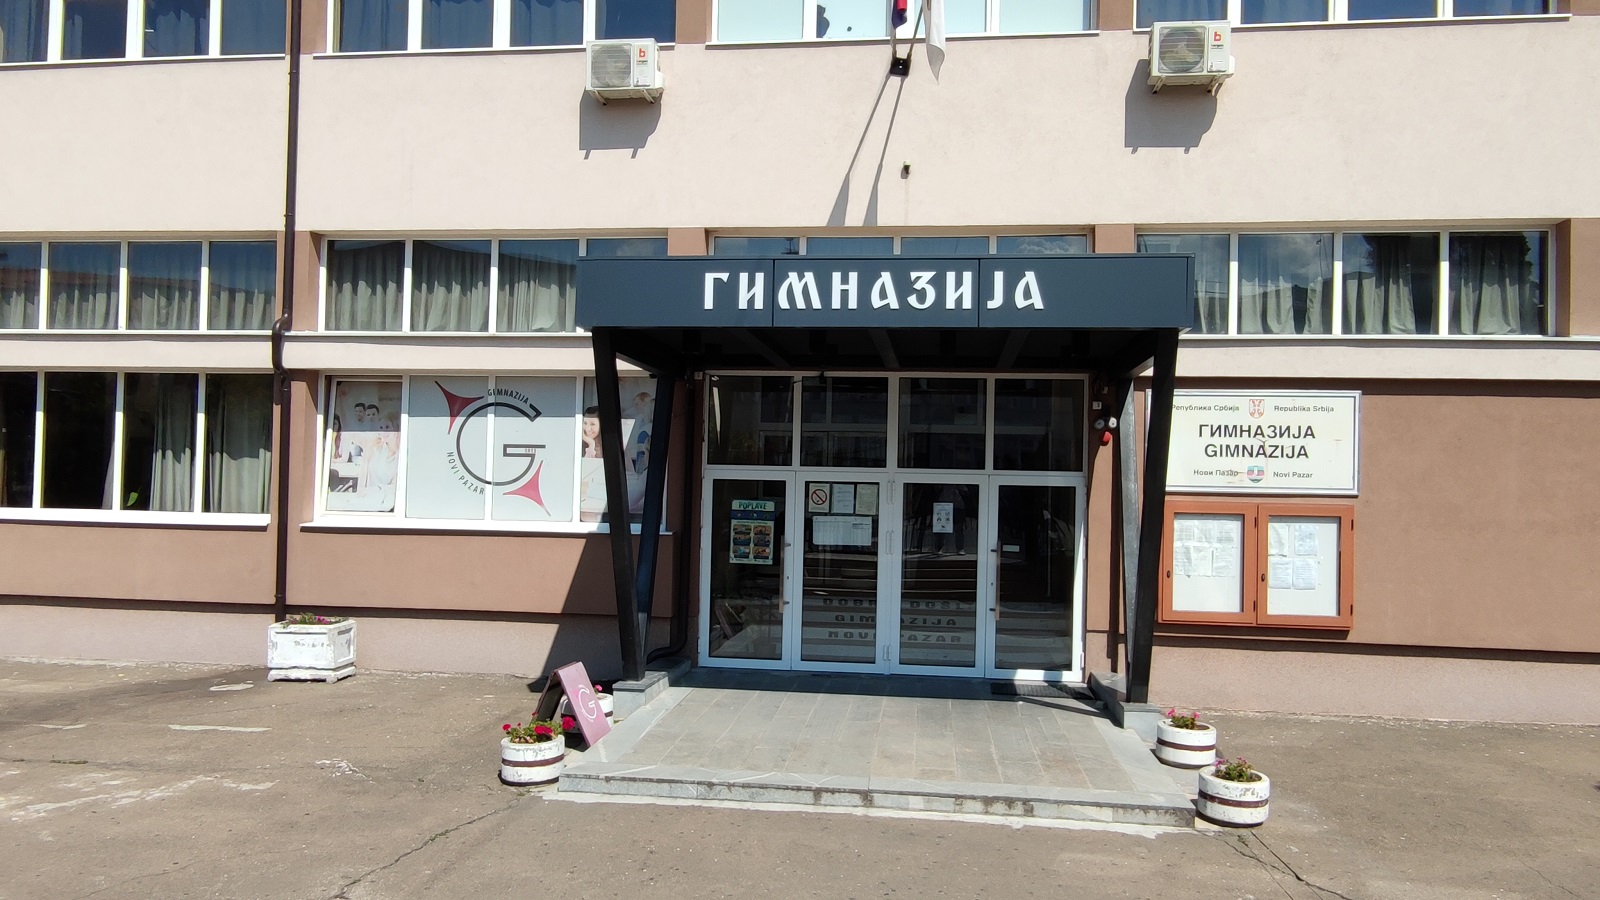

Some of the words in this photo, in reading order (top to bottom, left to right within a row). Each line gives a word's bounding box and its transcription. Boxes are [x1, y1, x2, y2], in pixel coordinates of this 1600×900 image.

[704, 271, 1045, 310] ГИМНАЗИЈА
[487, 388, 529, 404] GIMNAZIJA
[1213, 404, 1240, 412] Србија
[1274, 405, 1311, 413] Republika
[1313, 405, 1335, 413] Srbija
[1198, 424, 1316, 439] ГИМНАЗИЈА
[1204, 444, 1309, 459] GIMNAZIJA
[447, 451, 460, 474] NOVI
[458, 475, 485, 495] PAZAR
[1292, 471, 1313, 479] Pazar
[738, 501, 767, 509] POPLAVE
